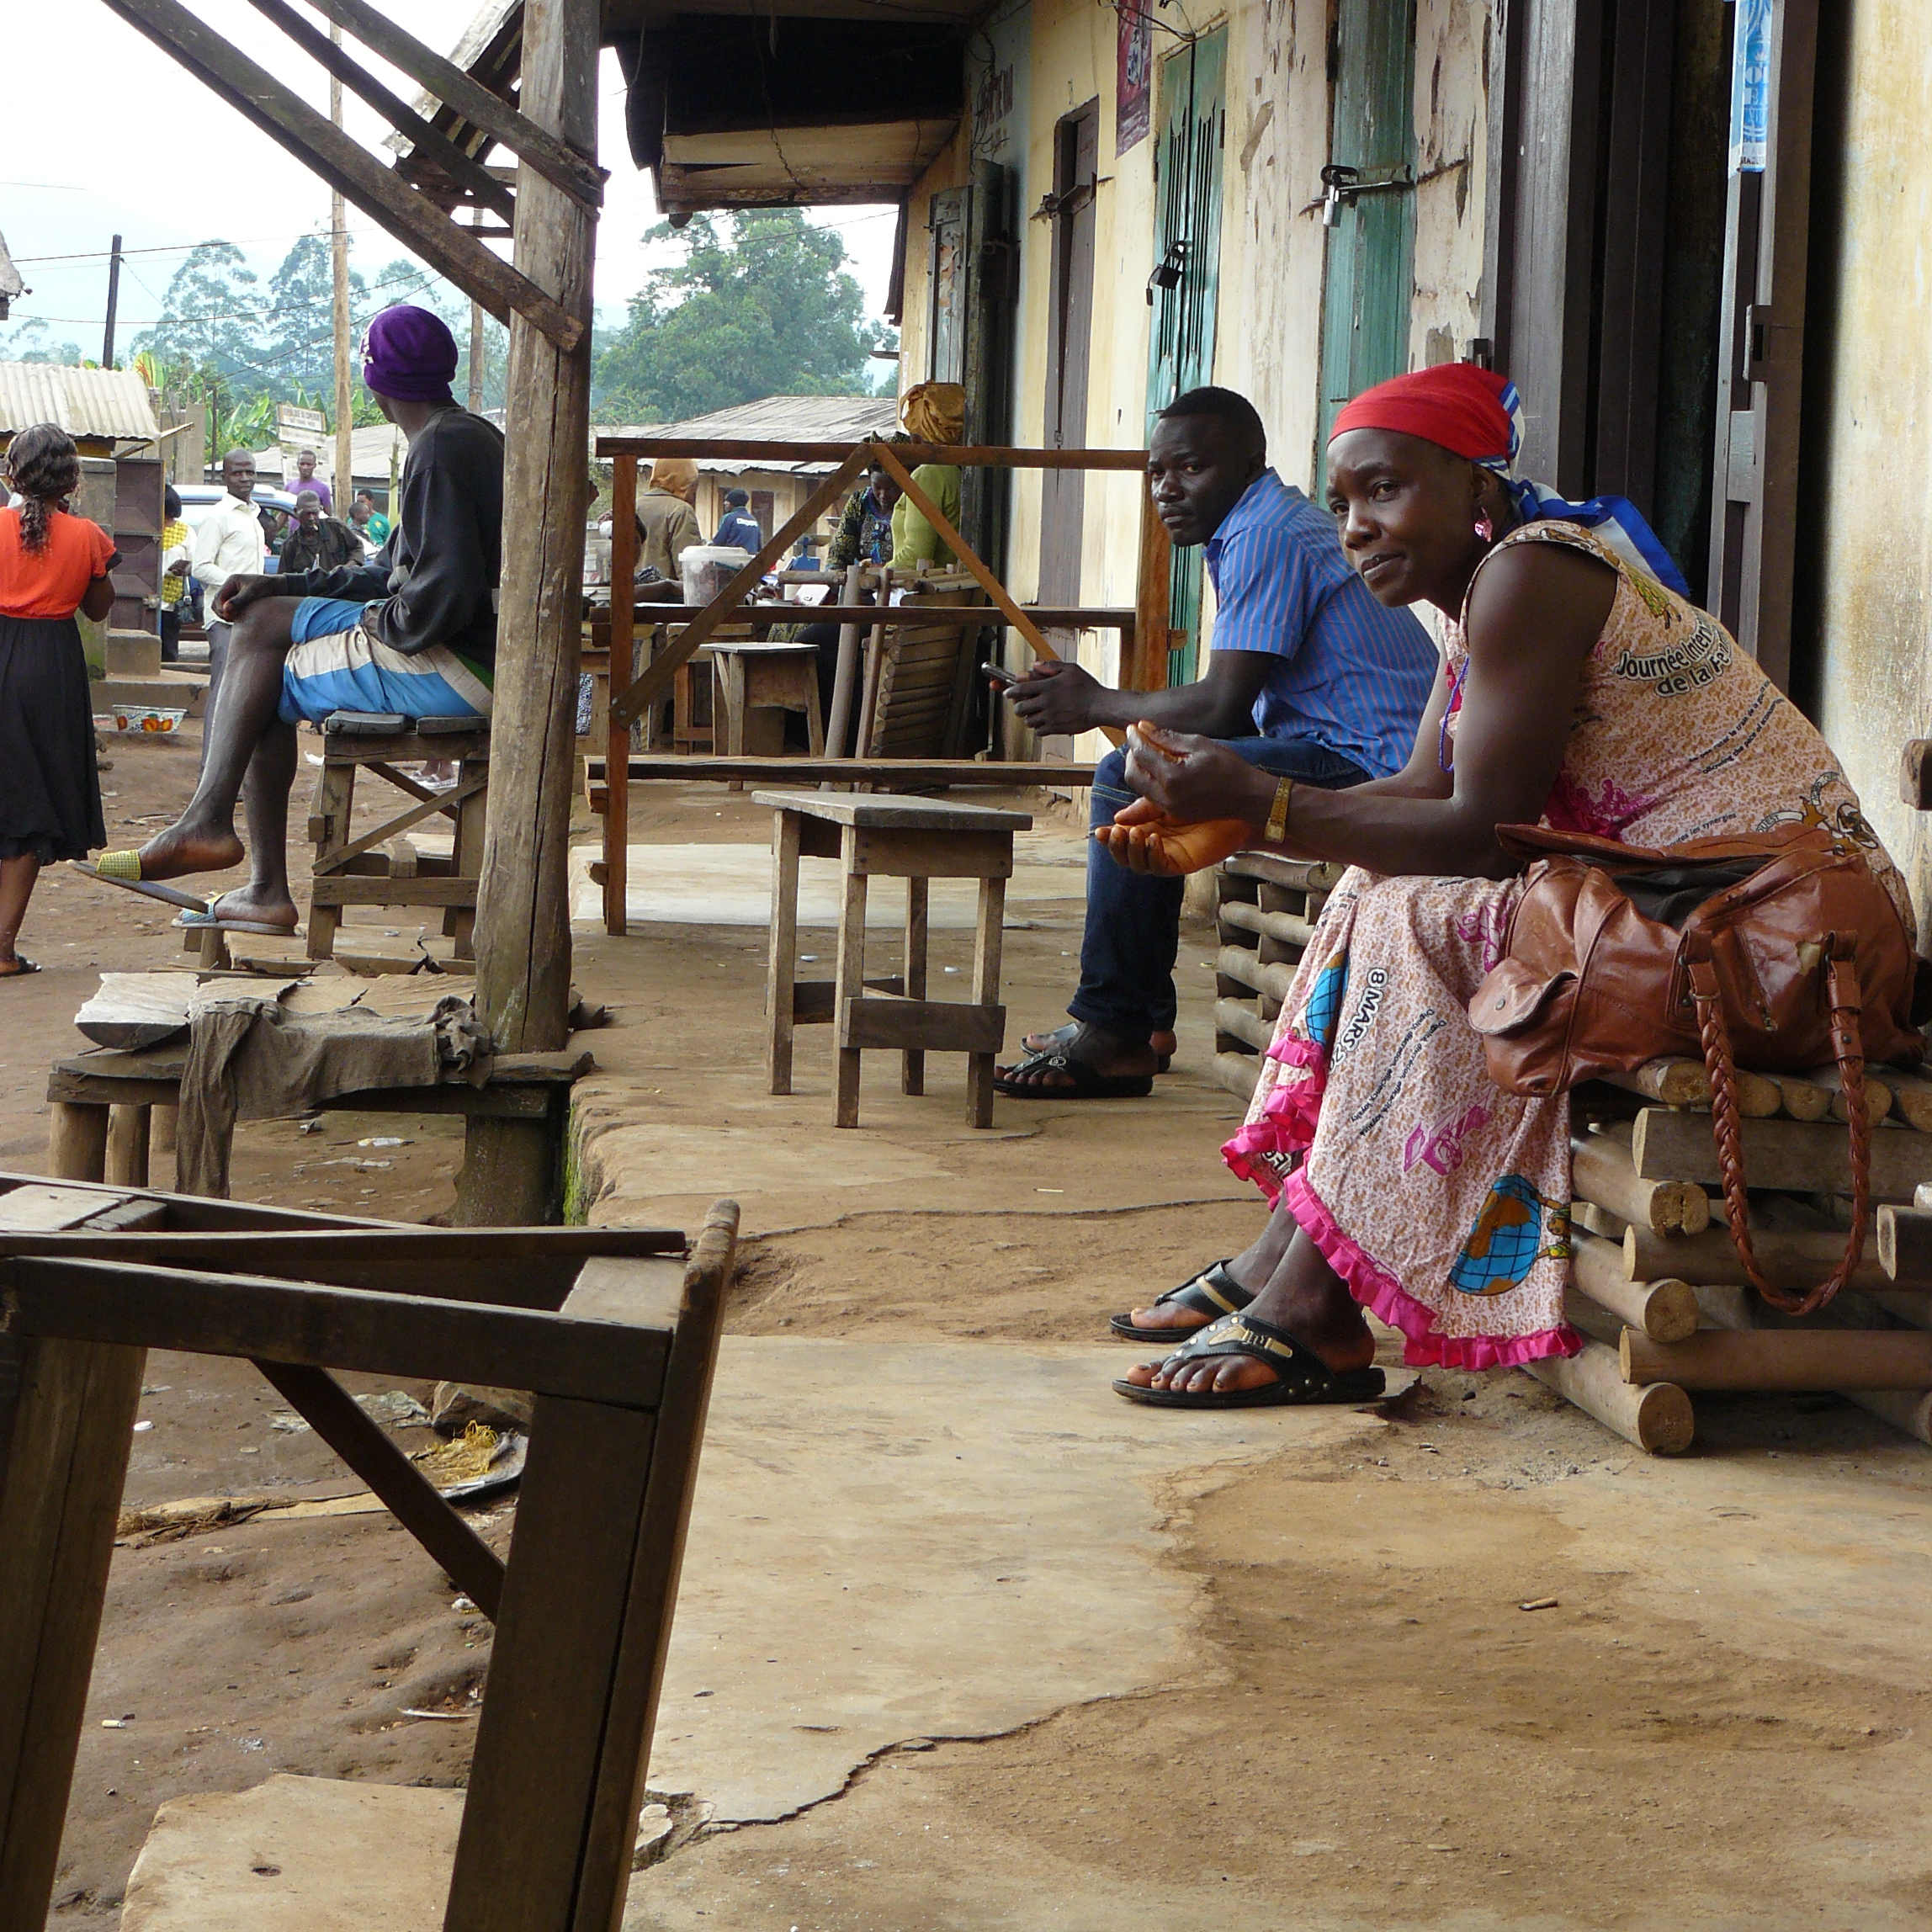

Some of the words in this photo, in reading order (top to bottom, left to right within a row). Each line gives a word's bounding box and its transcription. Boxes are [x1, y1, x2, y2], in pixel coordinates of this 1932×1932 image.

[1616, 649, 1688, 677] Journée
[1657, 676, 1688, 694] de
[1689, 668, 1711, 686] la
[1702, 755, 1734, 774] ollowing
[1690, 826, 1701, 835] les
[1702, 812, 1737, 830] synergies
[1371, 971, 1385, 985] 8
[1343, 990, 1381, 1048] MARS
[1351, 1102, 1374, 1123] loyalty
